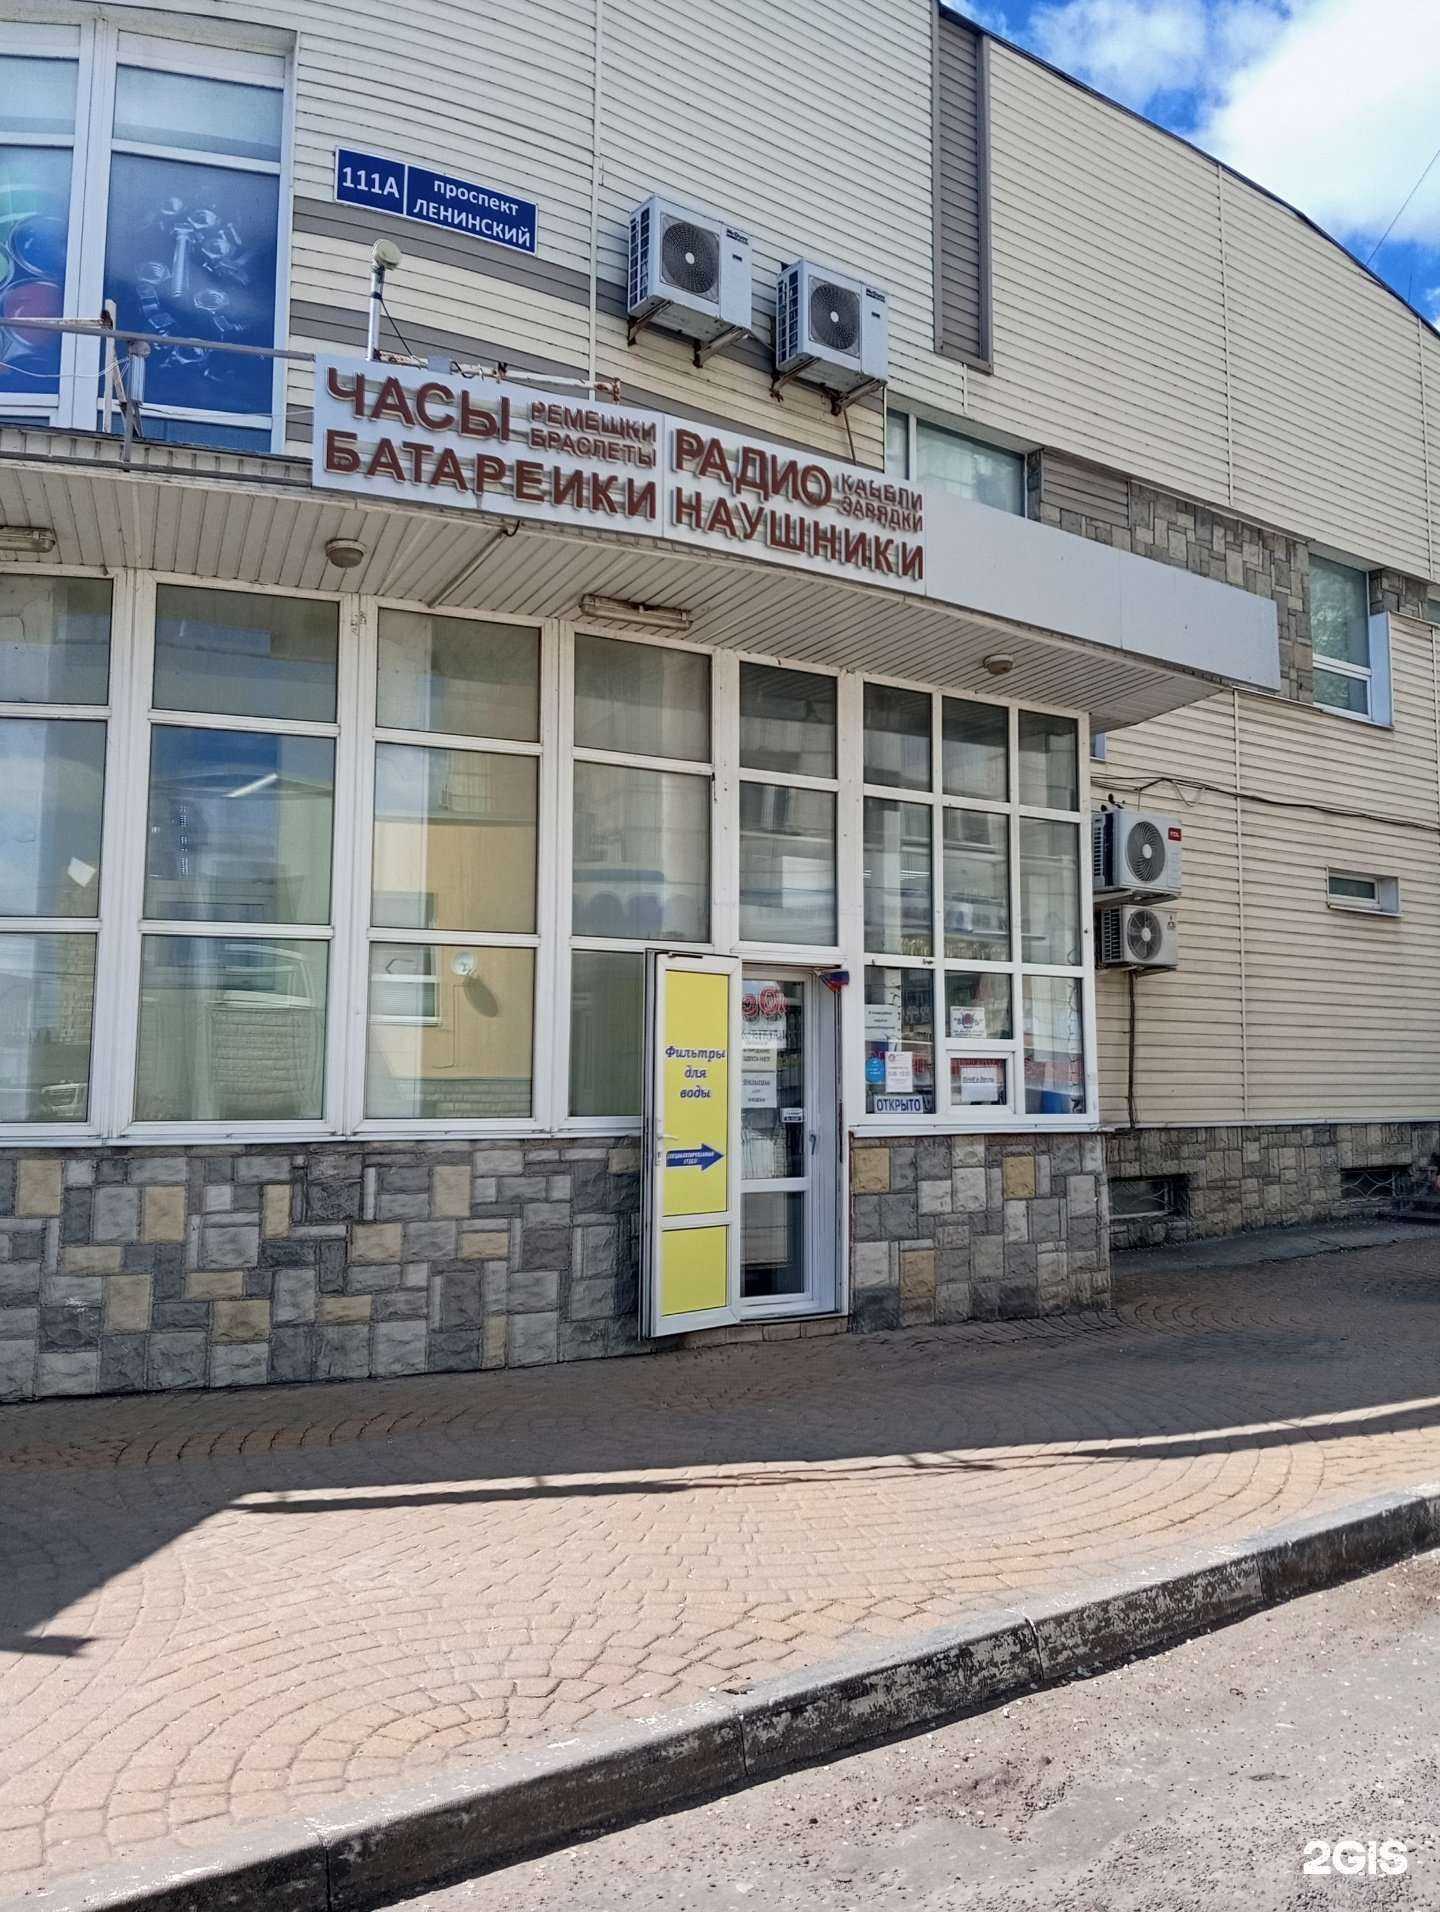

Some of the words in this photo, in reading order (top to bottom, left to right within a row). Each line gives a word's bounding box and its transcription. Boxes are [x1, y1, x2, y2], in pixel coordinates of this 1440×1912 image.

[342, 166, 400, 199] 111А
[434, 180, 519, 216] проспект
[413, 199, 531, 247] ЛЕНИНСКИЙ
[326, 367, 510, 443] ЧАСЫ
[530, 400, 657, 443] РЕМЕШКИ
[529, 427, 657, 468] БРАСЛЕТЫ
[673, 427, 832, 507] РАДИО
[674, 486, 925, 580] НАУШНИКИ
[839, 495, 923, 533] ЗАРЯДКИ
[665, 1045, 726, 1062] Фильтры
[684, 1065, 707, 1079] для
[680, 1085, 712, 1099] воды
[876, 1098, 922, 1112] ОТКРЫТО
